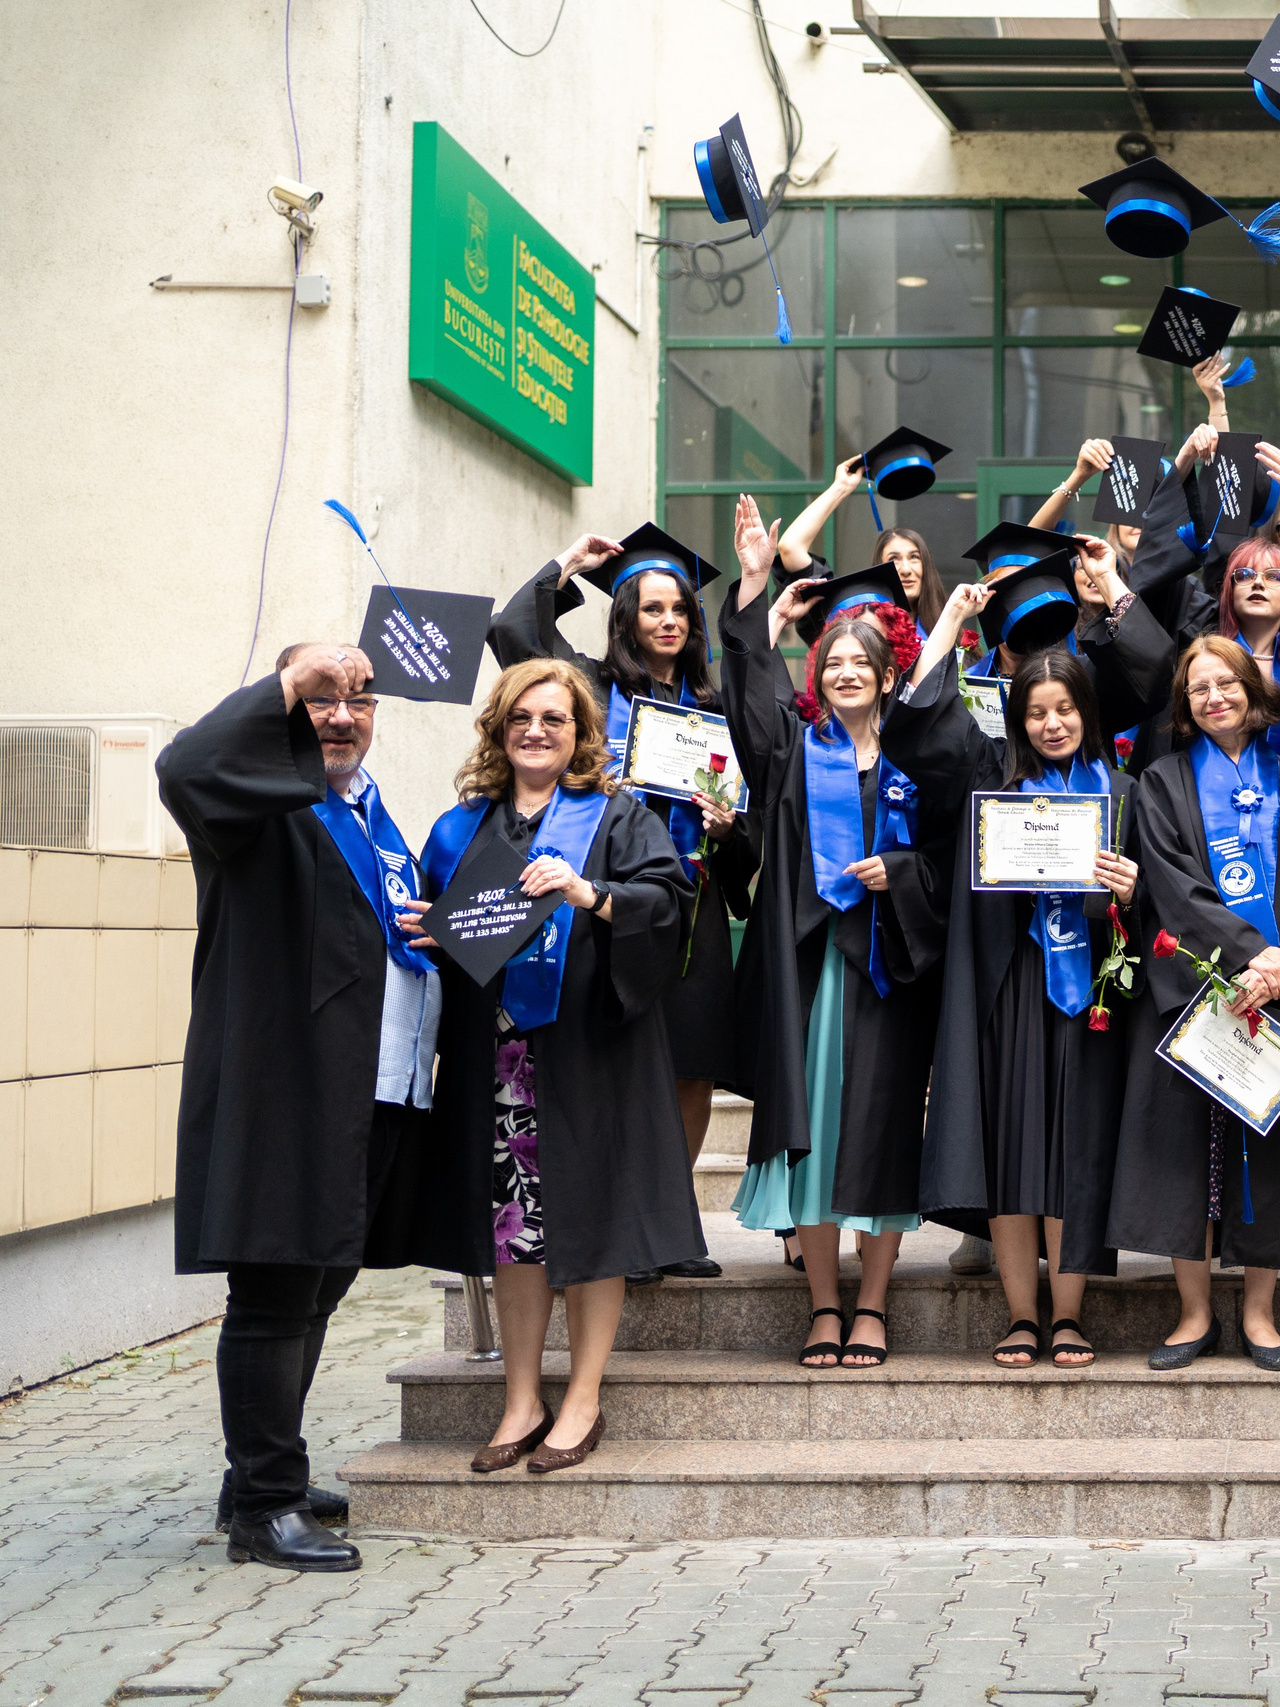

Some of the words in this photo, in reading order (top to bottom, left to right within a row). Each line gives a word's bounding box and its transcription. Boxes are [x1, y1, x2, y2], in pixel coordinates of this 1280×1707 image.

[519, 240, 576, 316] FACULTATEA
[444, 278, 492, 330] UNIVERSITATEA
[492, 320, 506, 340] DIN
[444, 298, 505, 366] BUCUREȘTI
[518, 284, 532, 318] DE
[532, 294, 590, 366] PSIHOLOGIE
[1191, 318, 1205, 337] 2024
[517, 326, 526, 358] ȘI
[1128, 464, 1139, 486] 2024
[1230, 464, 1240, 488] 2024
[384, 617, 396, 631] WE
[381, 633, 394, 647] THE
[392, 628, 407, 643] BUT
[422, 622, 448, 649] 2024
[390, 646, 404, 660] SEE
[427, 652, 440, 667] THE
[404, 640, 438, 683] DISABILITIES,
[437, 665, 450, 680] SEE
[676, 733, 708, 749] Diplomă
[1024, 822, 1060, 832] Diplomă
[477, 888, 506, 903] 2024
[502, 903, 517, 911] THE
[517, 901, 532, 909] SEE
[450, 921, 463, 930] WE
[463, 919, 478, 928] BUT
[479, 912, 527, 925] DISABILITIES,
[460, 931, 475, 939] THE
[476, 929, 490, 937] SEE
[1232, 1027, 1263, 1056] Diplomă
